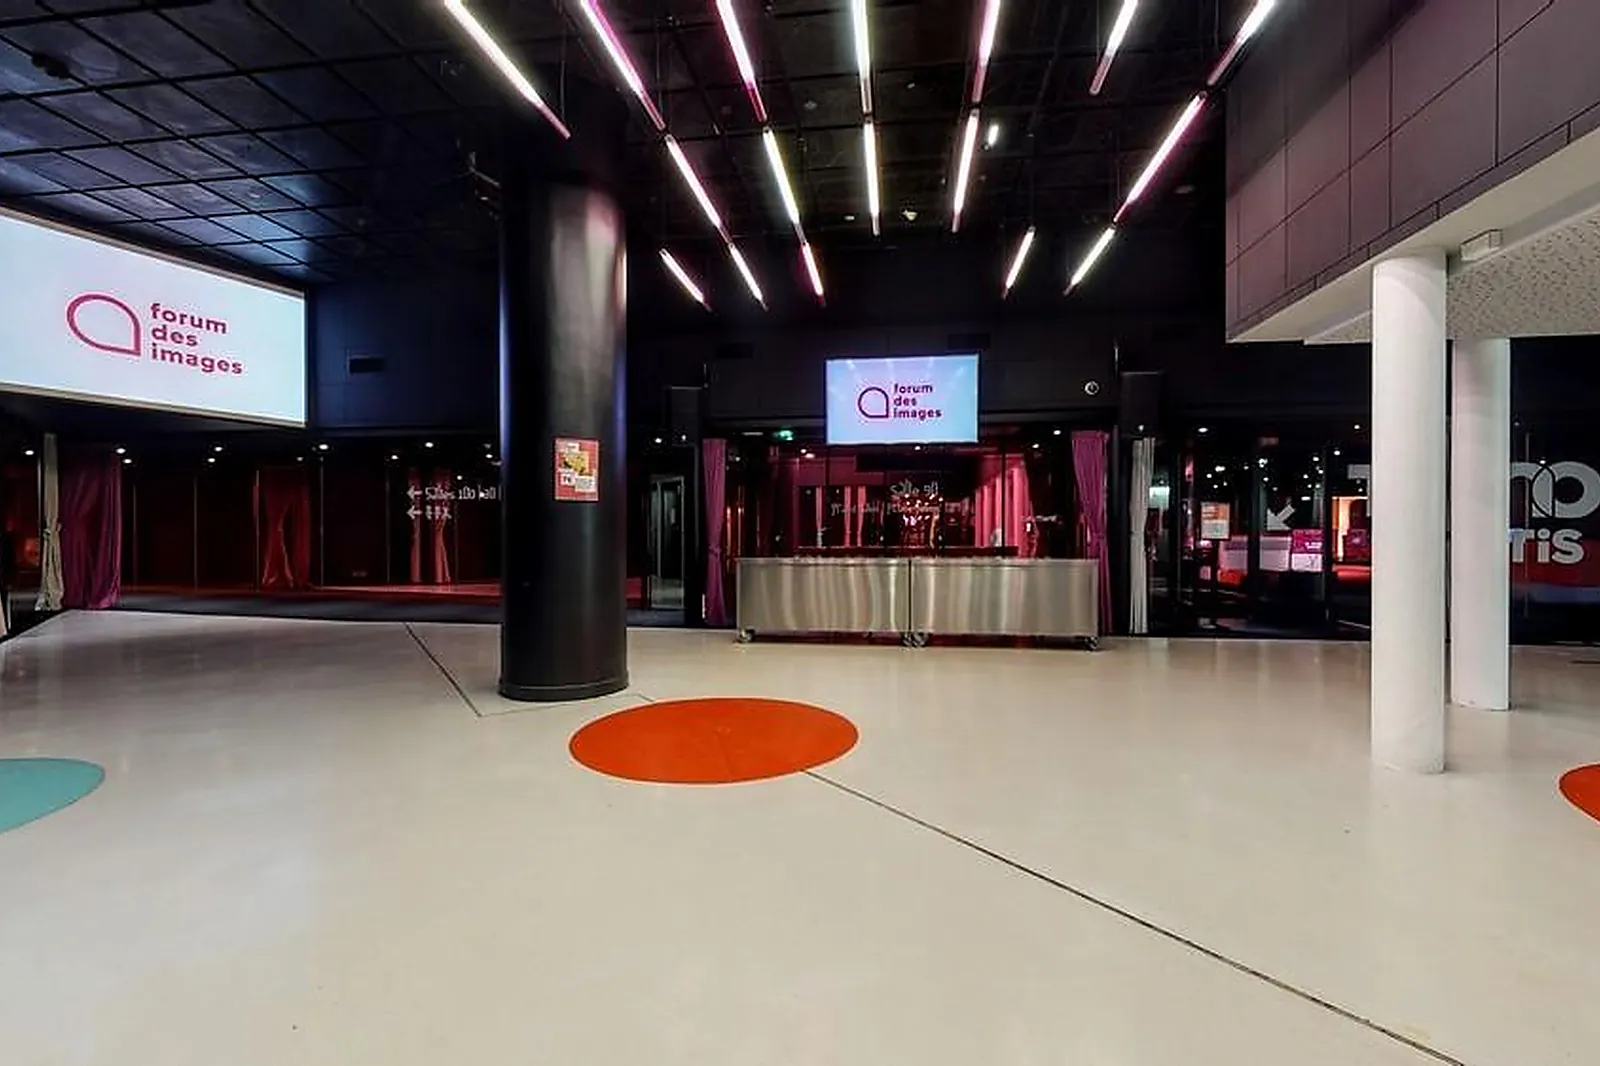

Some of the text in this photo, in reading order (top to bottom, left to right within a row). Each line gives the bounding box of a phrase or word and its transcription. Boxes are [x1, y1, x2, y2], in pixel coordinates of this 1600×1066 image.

[150, 302, 227, 335] forum
[151, 325, 198, 348] des
[151, 343, 243, 375] images
[893, 383, 933, 394] forum
[893, 395, 917, 407] des
[893, 407, 942, 421] images
